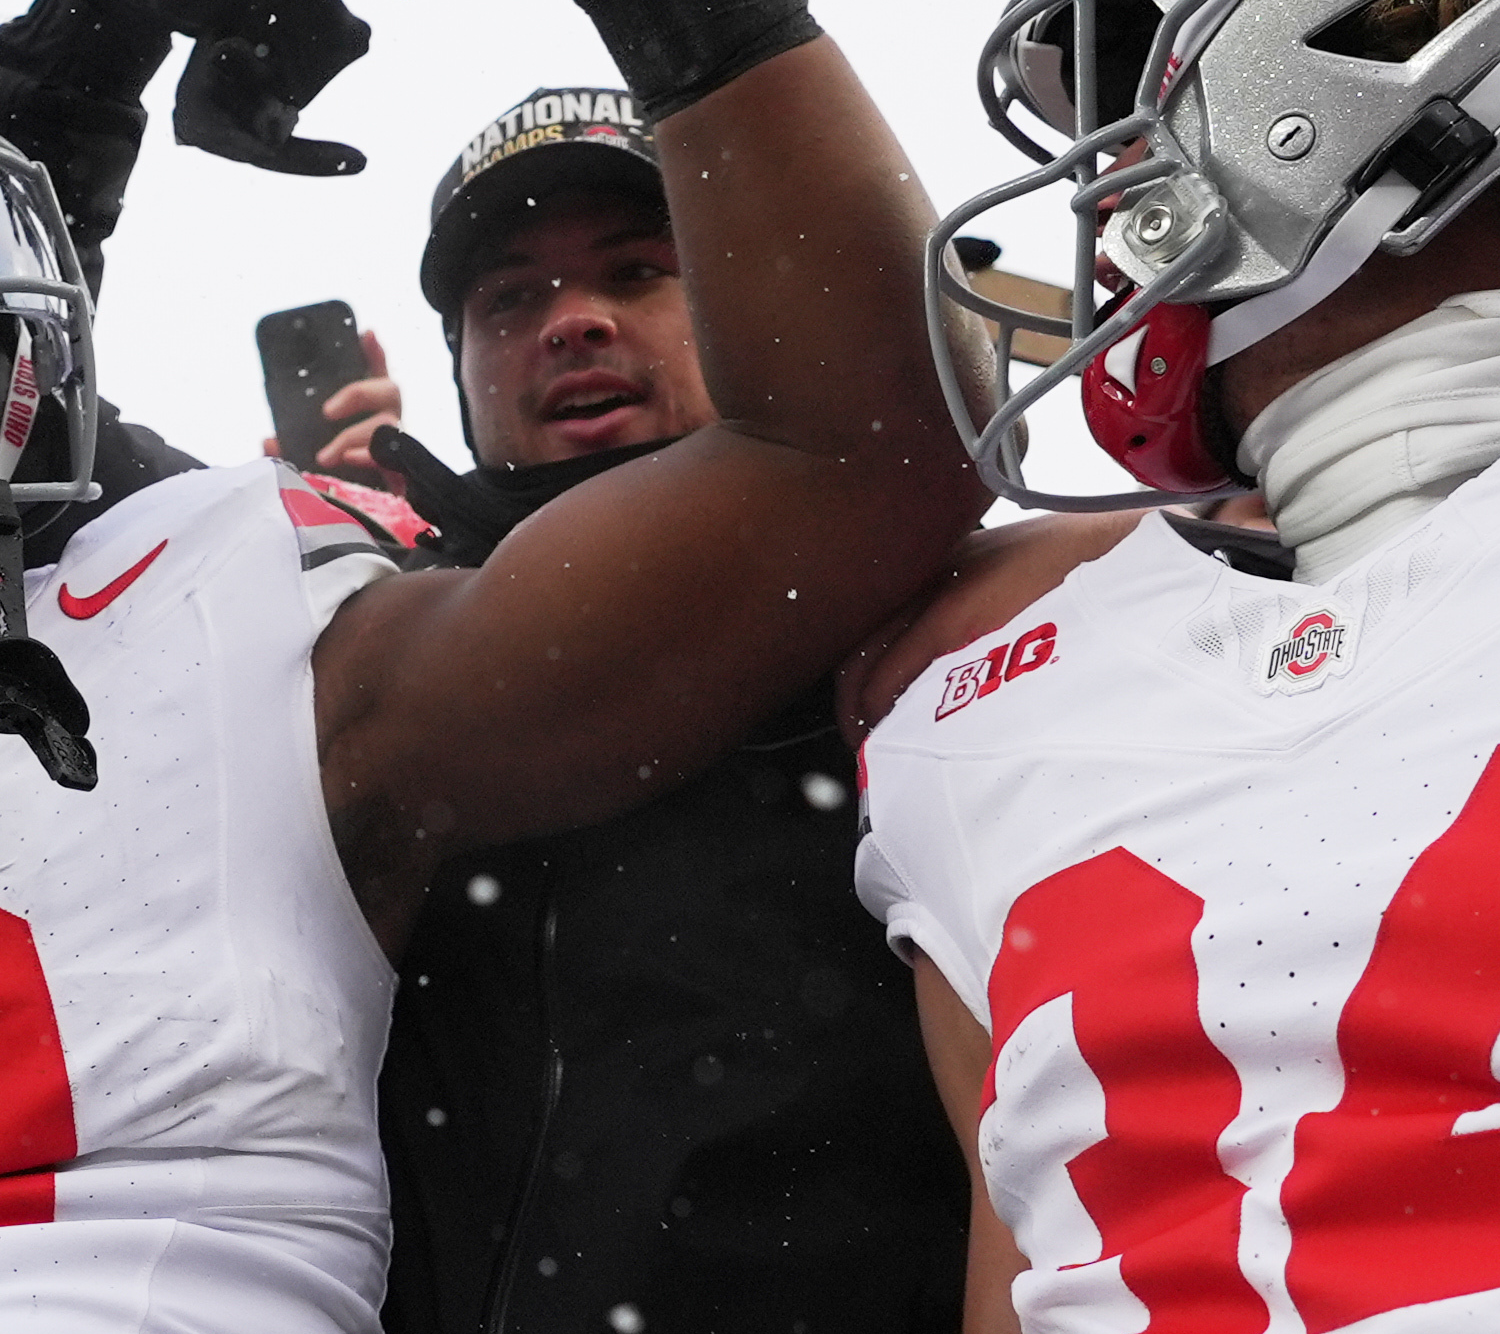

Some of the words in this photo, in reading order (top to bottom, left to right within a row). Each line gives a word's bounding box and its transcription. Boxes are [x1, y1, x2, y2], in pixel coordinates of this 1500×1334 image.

[461, 92, 645, 175] NATIONAL
[12, 354, 38, 399] STATE
[3, 399, 34, 448] OHIO
